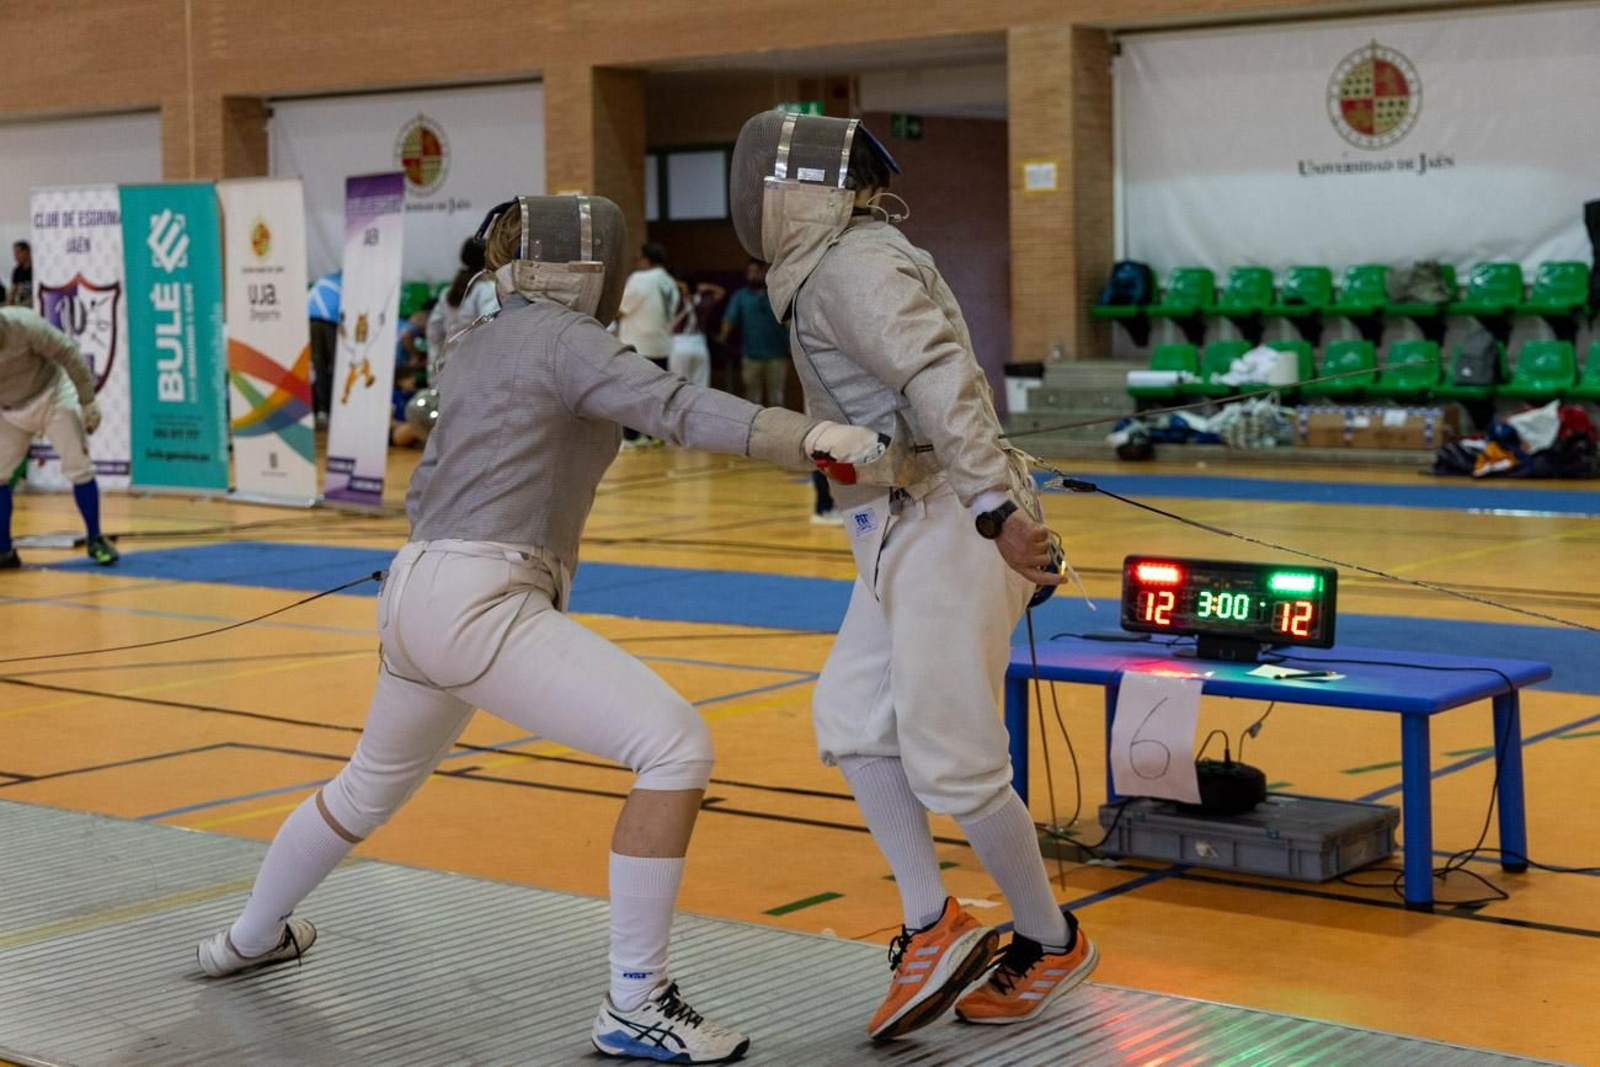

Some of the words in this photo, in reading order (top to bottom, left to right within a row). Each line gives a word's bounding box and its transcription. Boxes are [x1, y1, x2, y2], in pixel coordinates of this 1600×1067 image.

[33, 211, 59, 229] CLUB
[62, 210, 75, 228] DE
[1145, 591, 1175, 626] 12
[1197, 591, 1250, 621] 3:00
[1281, 600, 1313, 636] 12
[1129, 696, 1171, 780] 6
